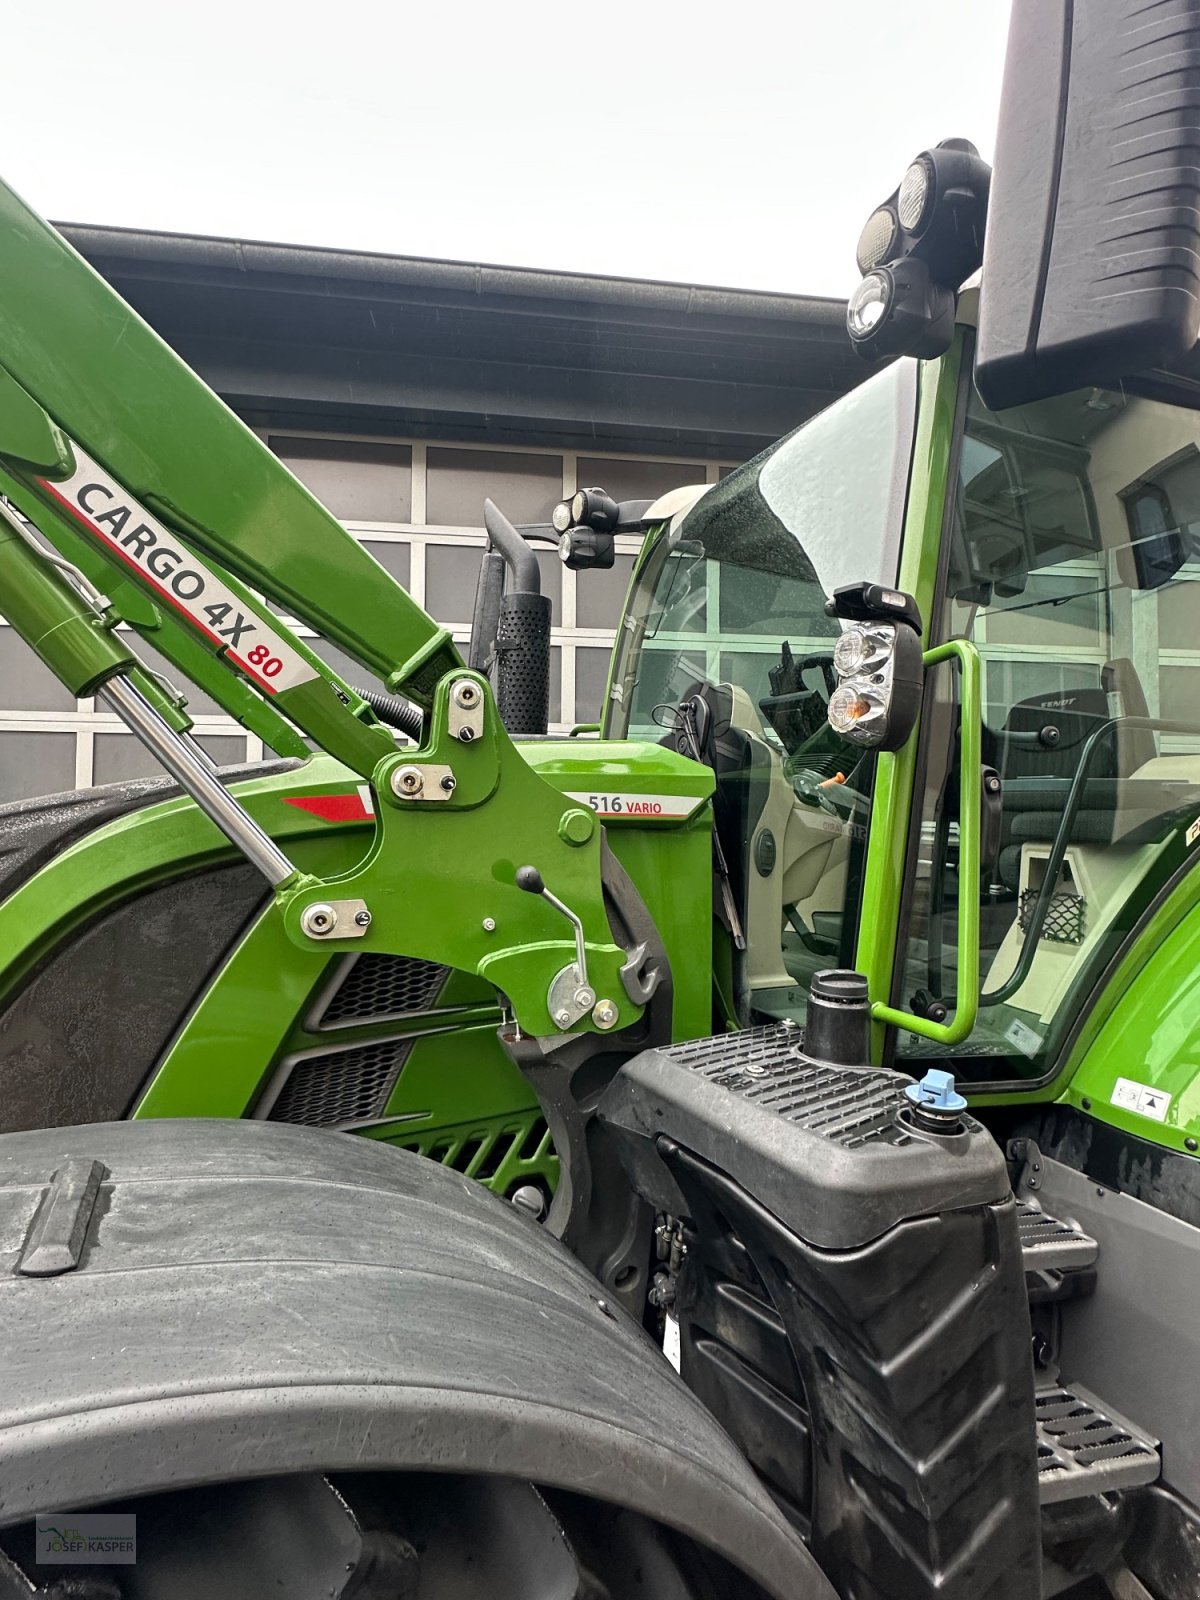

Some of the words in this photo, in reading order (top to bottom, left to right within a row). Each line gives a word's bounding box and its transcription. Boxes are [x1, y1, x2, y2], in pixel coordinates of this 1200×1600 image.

[76, 483, 205, 600] CARGO
[203, 602, 257, 648] 4X
[247, 644, 283, 678] 80
[1040, 697, 1077, 709] FENDT
[589, 796, 622, 812] 516
[626, 802, 662, 813] VARIO
